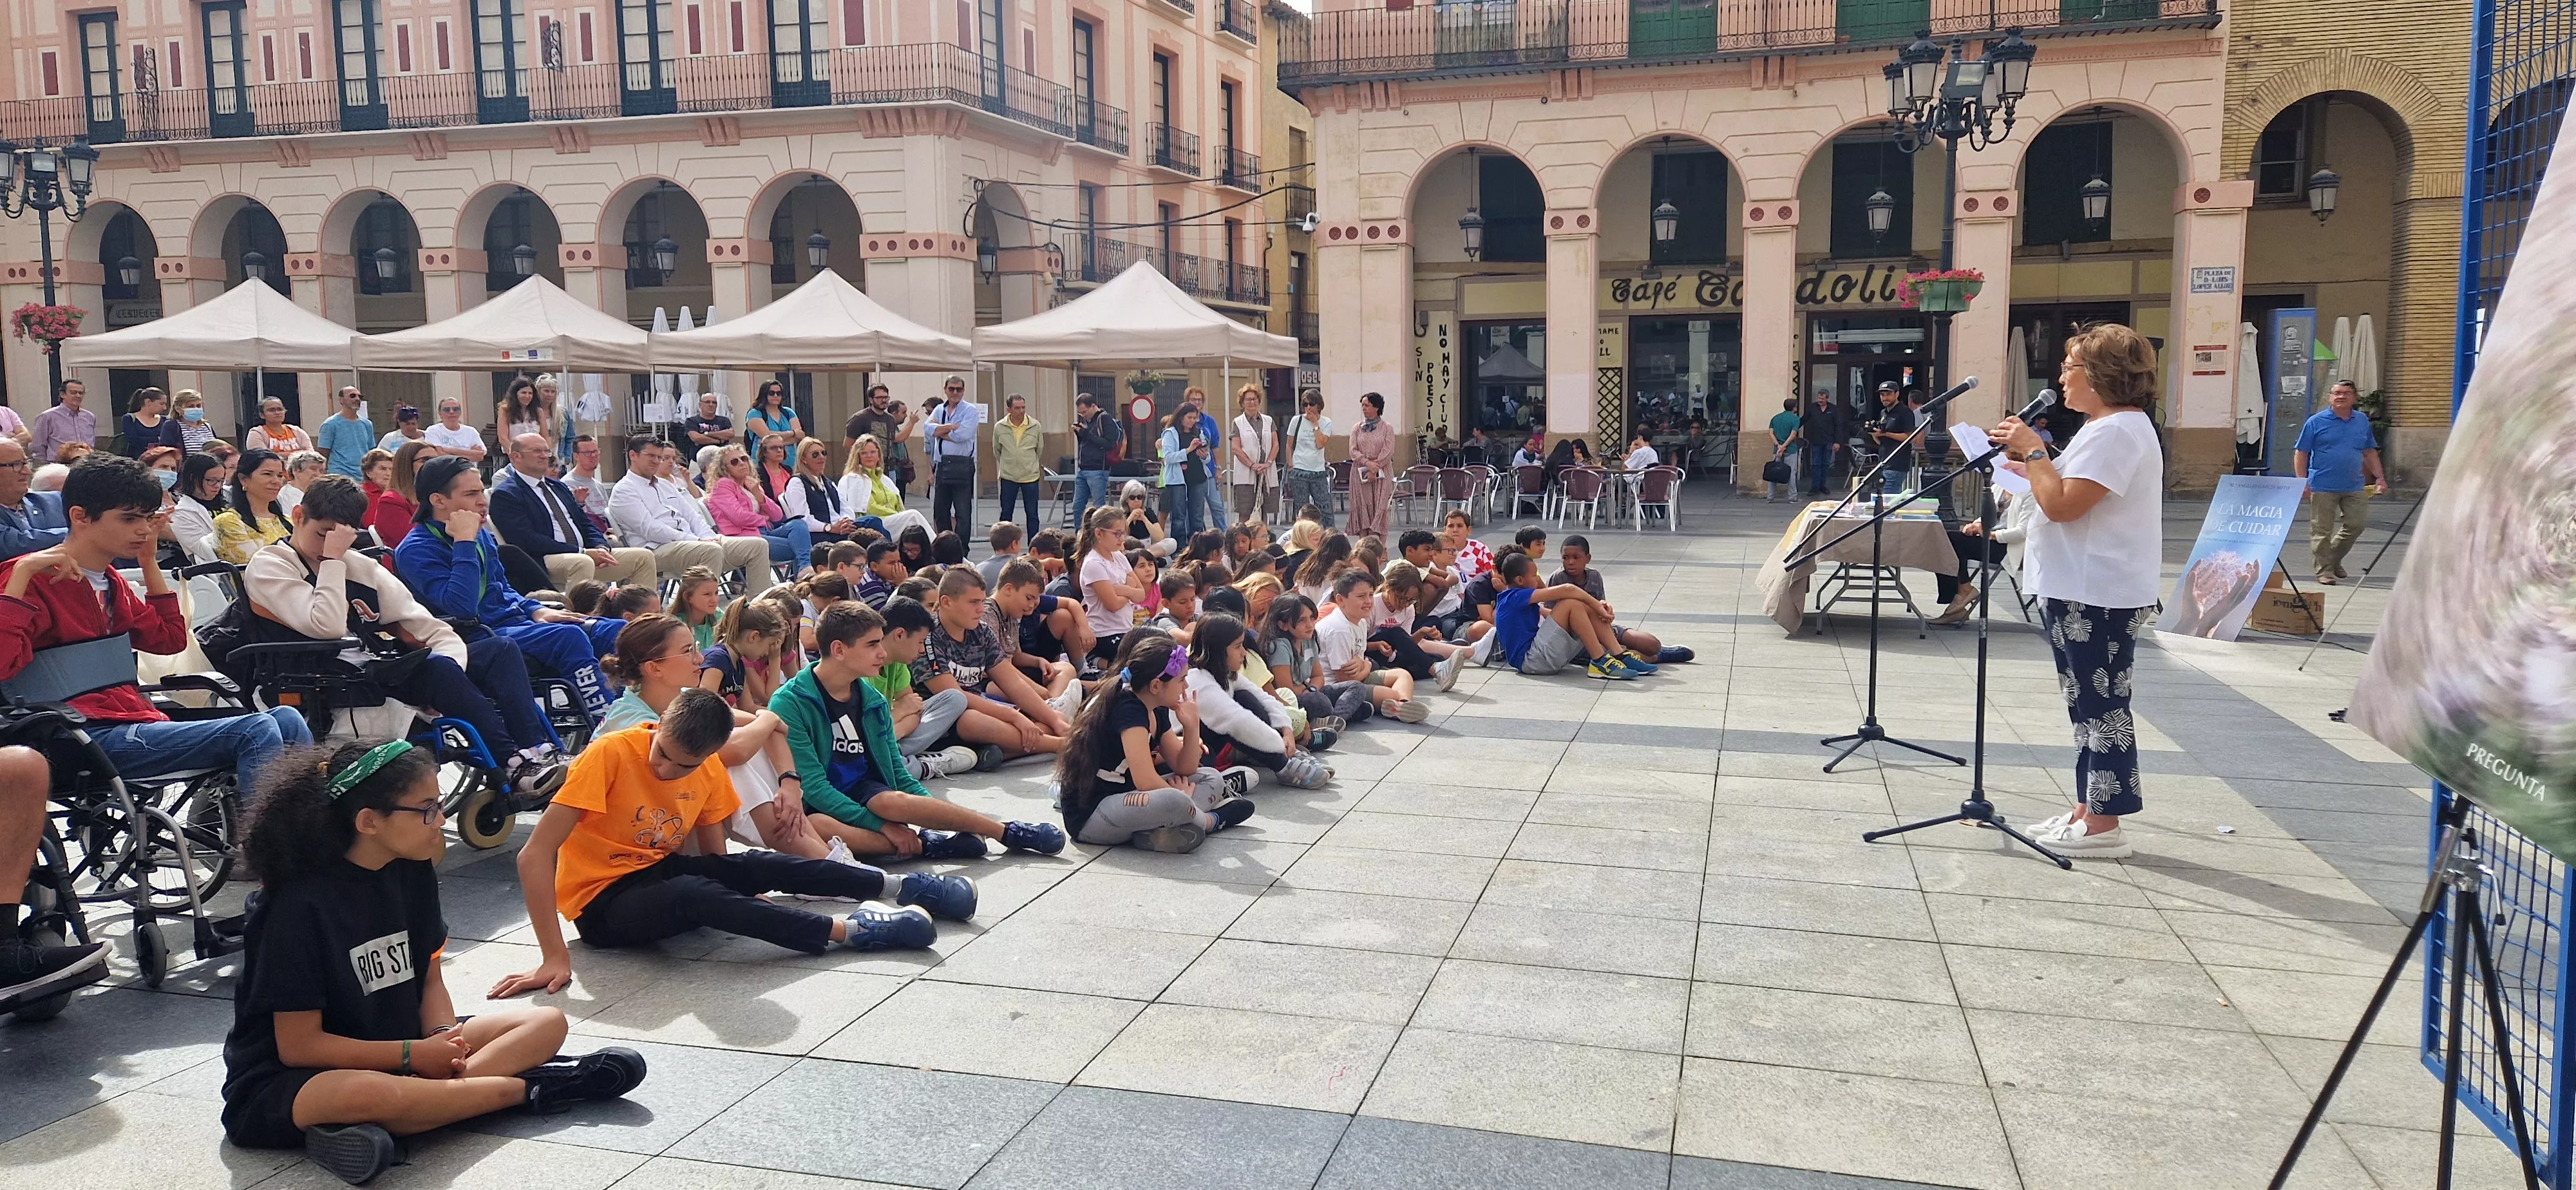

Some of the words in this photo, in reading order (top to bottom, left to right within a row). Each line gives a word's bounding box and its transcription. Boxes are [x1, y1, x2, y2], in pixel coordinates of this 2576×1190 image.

[1611, 274, 1681, 309] Café
[2219, 504, 2233, 516] LA
[2237, 504, 2283, 519] MAGIA
[2208, 520, 2227, 532] DE
[2229, 520, 2282, 536] CUIDAR
[833, 739, 864, 753] idas
[2465, 742, 2546, 802] PREGUNTA
[357, 950, 385, 985] BIG
